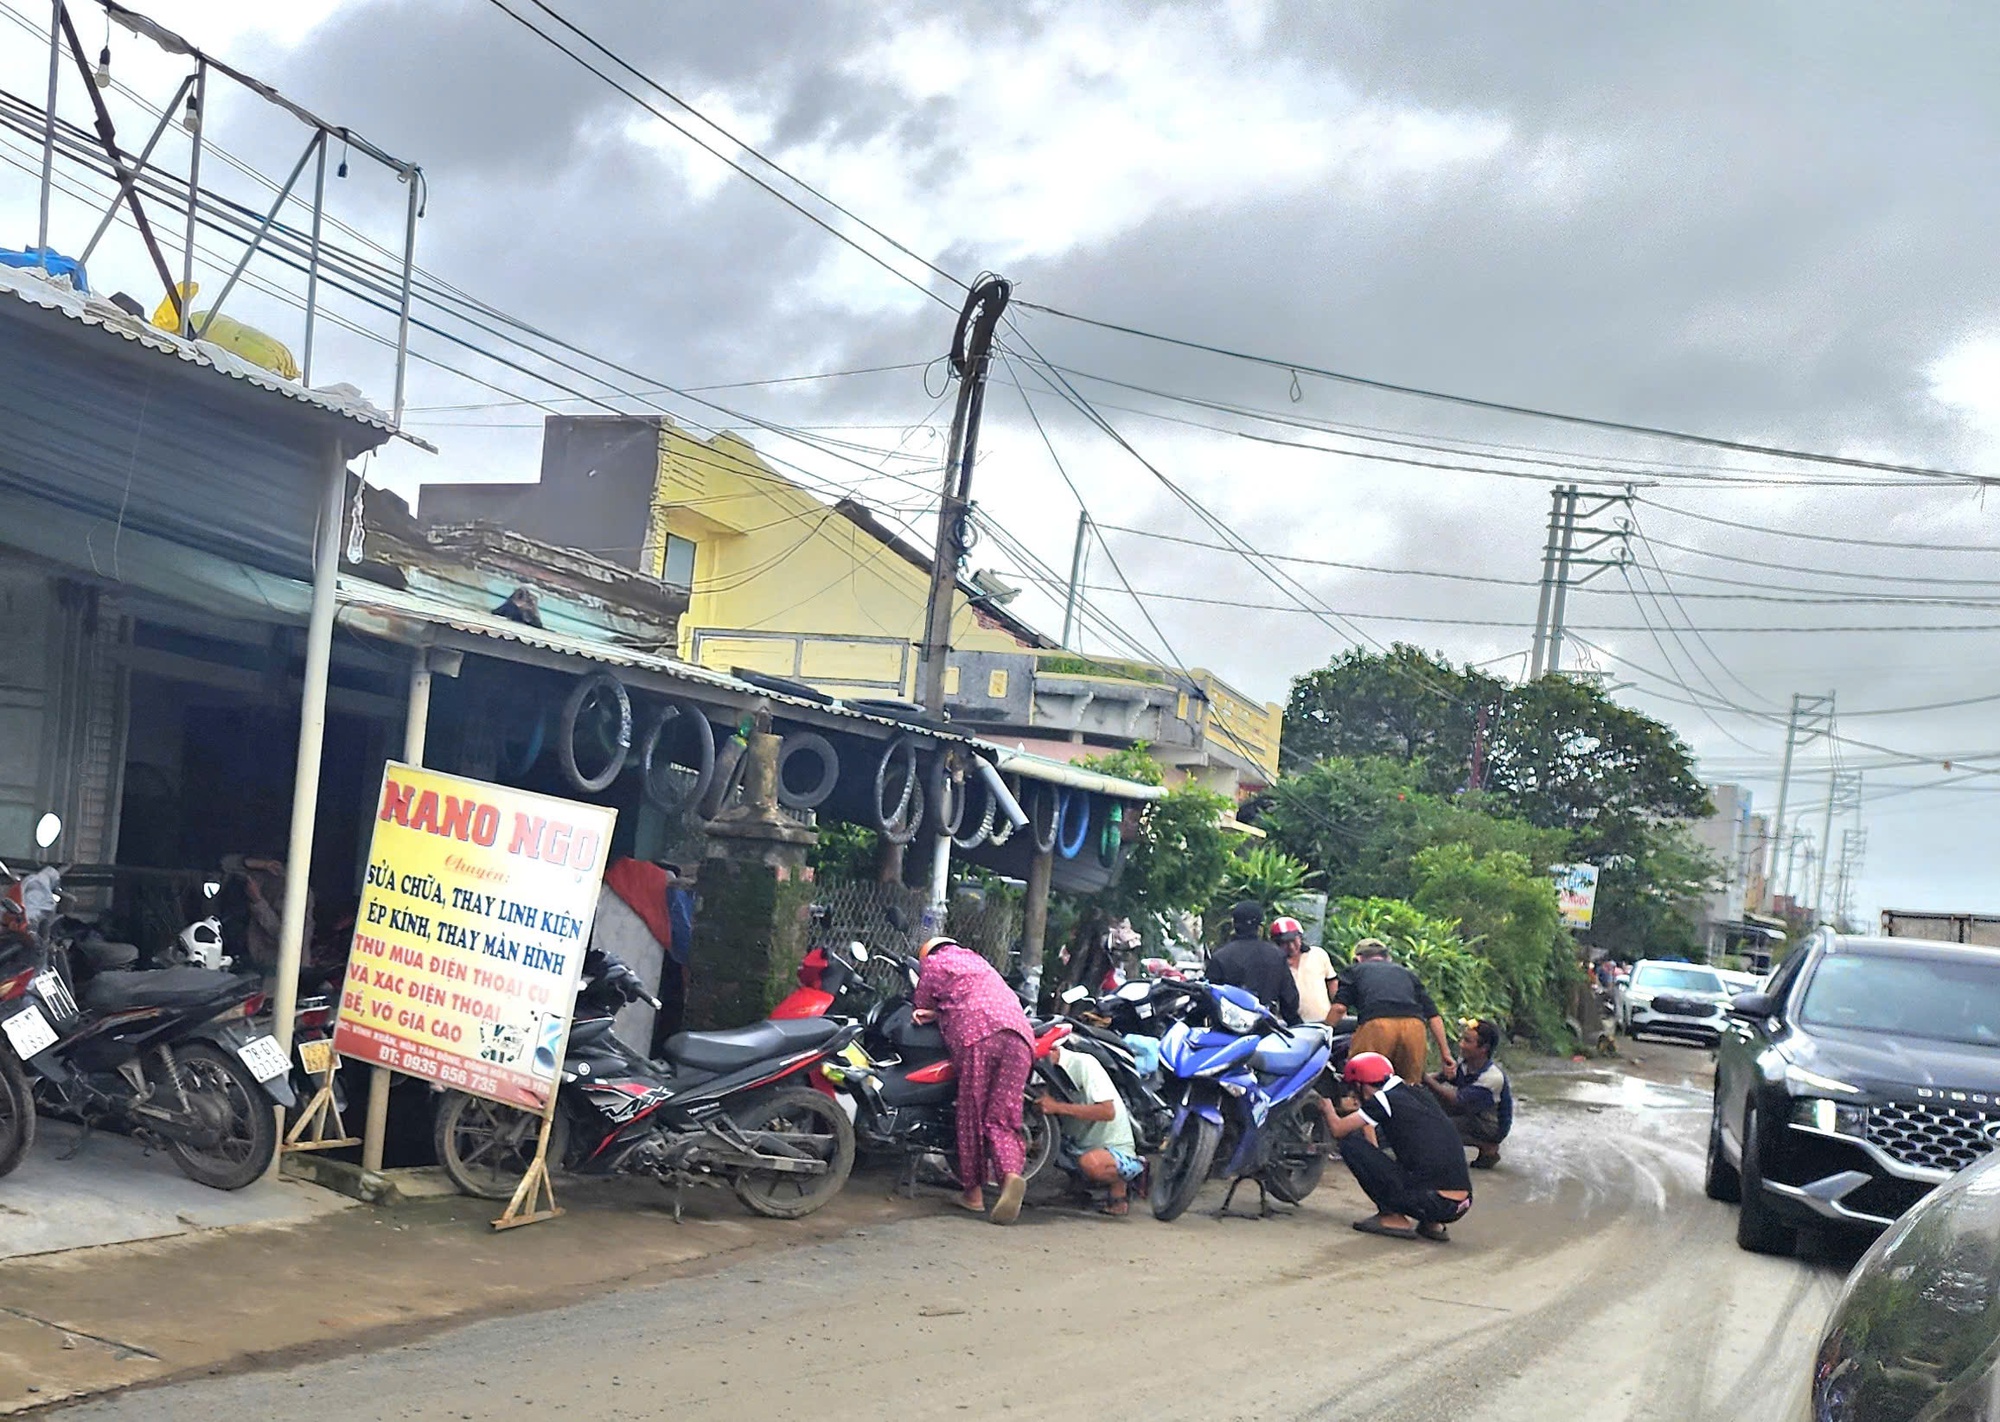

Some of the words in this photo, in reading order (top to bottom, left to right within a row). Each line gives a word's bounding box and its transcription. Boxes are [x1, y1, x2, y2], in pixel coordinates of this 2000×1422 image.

[379, 780, 499, 847] NANO
[508, 812, 599, 883] NGỌ
[367, 859, 395, 892] SỬA
[401, 874, 446, 909] CHỮA,
[452, 887, 496, 917] THAY
[498, 900, 538, 928] LINH
[541, 910, 583, 943] KIỆN
[355, 934, 385, 957] THU
[389, 945, 423, 969] MUA
[367, 897, 387, 924] ÉP
[389, 906, 430, 943] KÍNH,
[437, 922, 480, 951] THAY
[482, 932, 520, 962] MÀN
[522, 942, 565, 975] HÌNH
[431, 1019, 462, 1043] CAO
[402, 1053, 438, 1076] 0935
